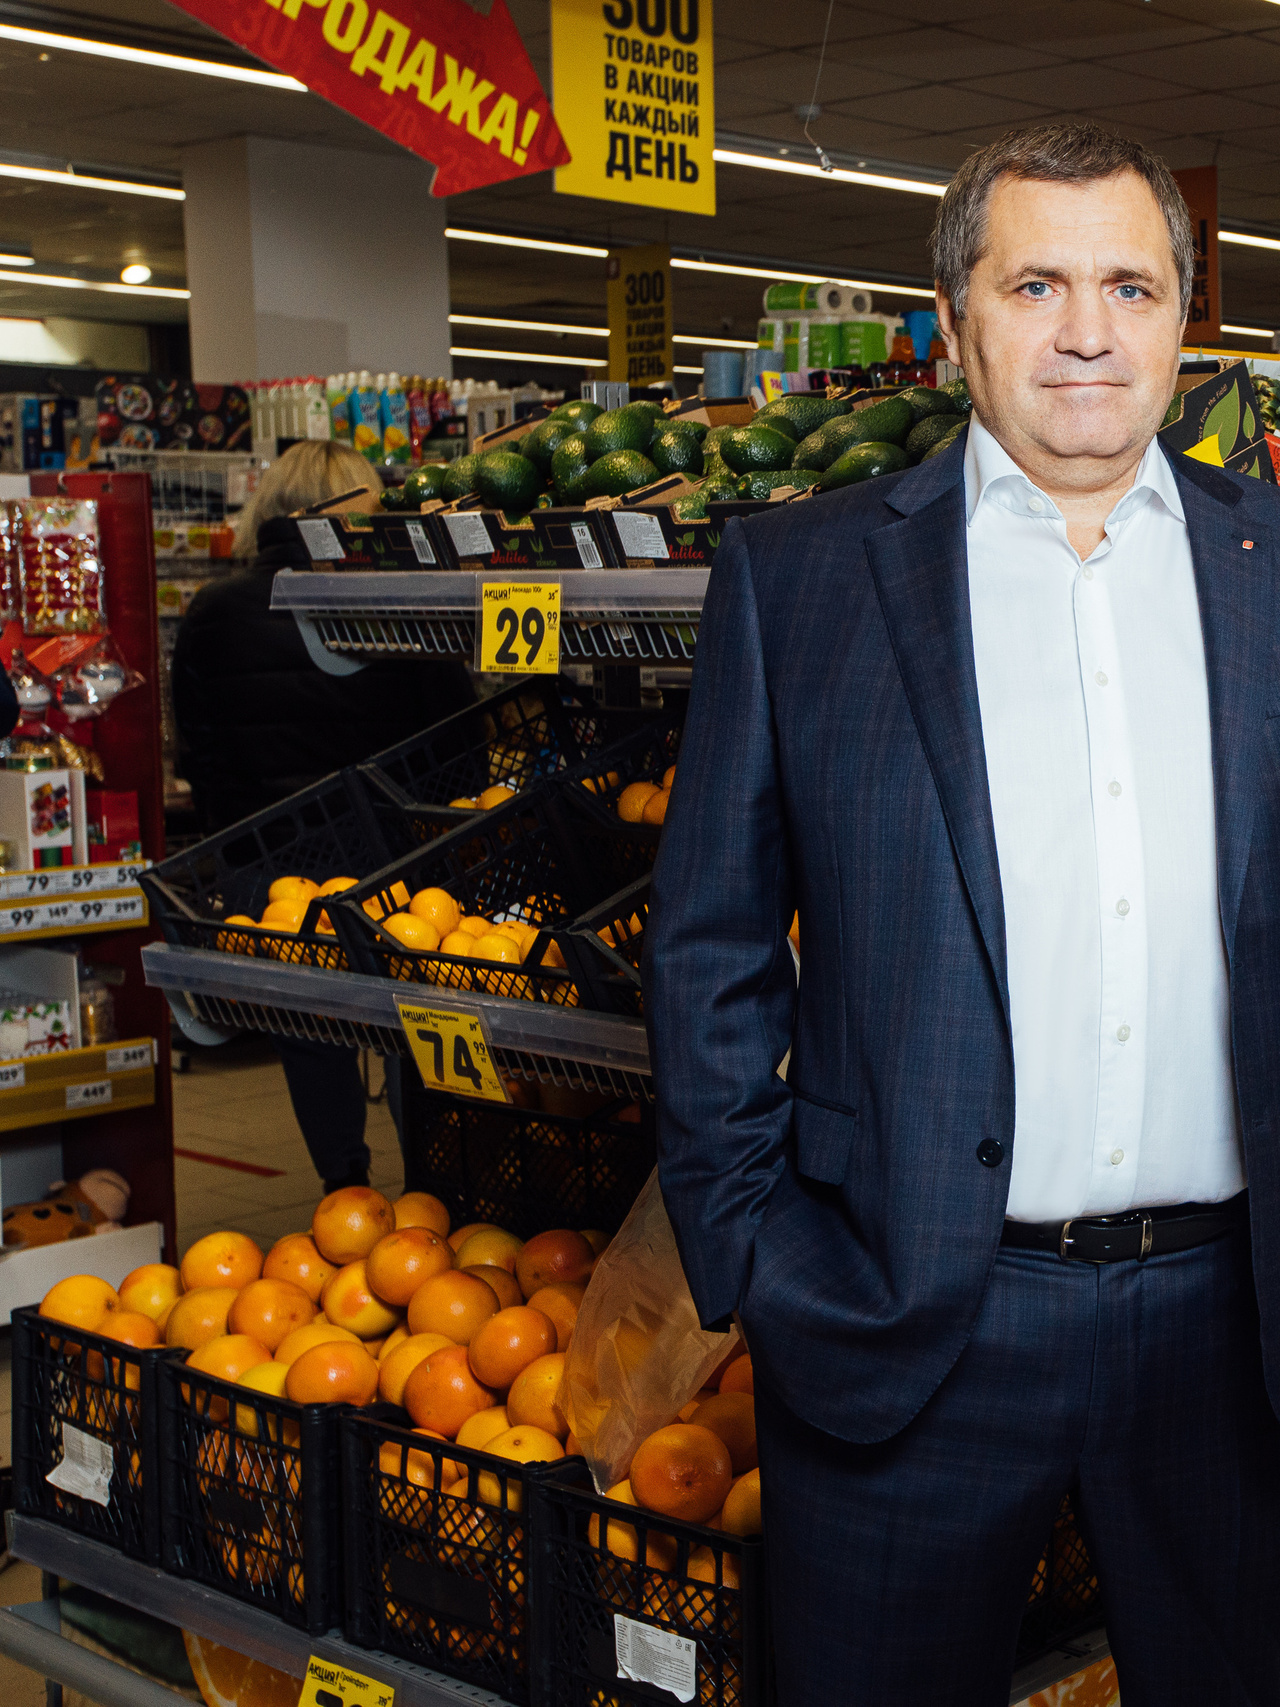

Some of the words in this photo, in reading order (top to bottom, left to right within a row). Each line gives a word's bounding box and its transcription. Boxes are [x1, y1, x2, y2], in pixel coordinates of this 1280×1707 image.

[604, 32, 698, 76] ТОВАРОВ
[264, 0, 541, 167] РОДАЖА!
[604, 63, 618, 90] В
[627, 69, 699, 106] АКЦИИ
[605, 97, 699, 138] КАЖДЫЙ
[606, 130, 699, 184] ДЕНЬ
[625, 270, 665, 305] 300
[627, 355, 666, 382] ДЕНЬ
[577, 528, 586, 537] 16
[484, 588, 511, 600] АКЦИЯ!
[495, 607, 545, 666] 29
[547, 611, 558, 623] 99
[26, 875, 49, 891] 79
[72, 871, 93, 887] 59
[118, 867, 138, 883] 59
[11, 909, 34, 926] 99
[81, 902, 103, 919] 99
[402, 1009, 429, 1024] АКЦИЯ!
[416, 1028, 482, 1090] 74
[473, 1041, 485, 1054] 99
[308, 1663, 339, 1685] АКЦИЯ!
